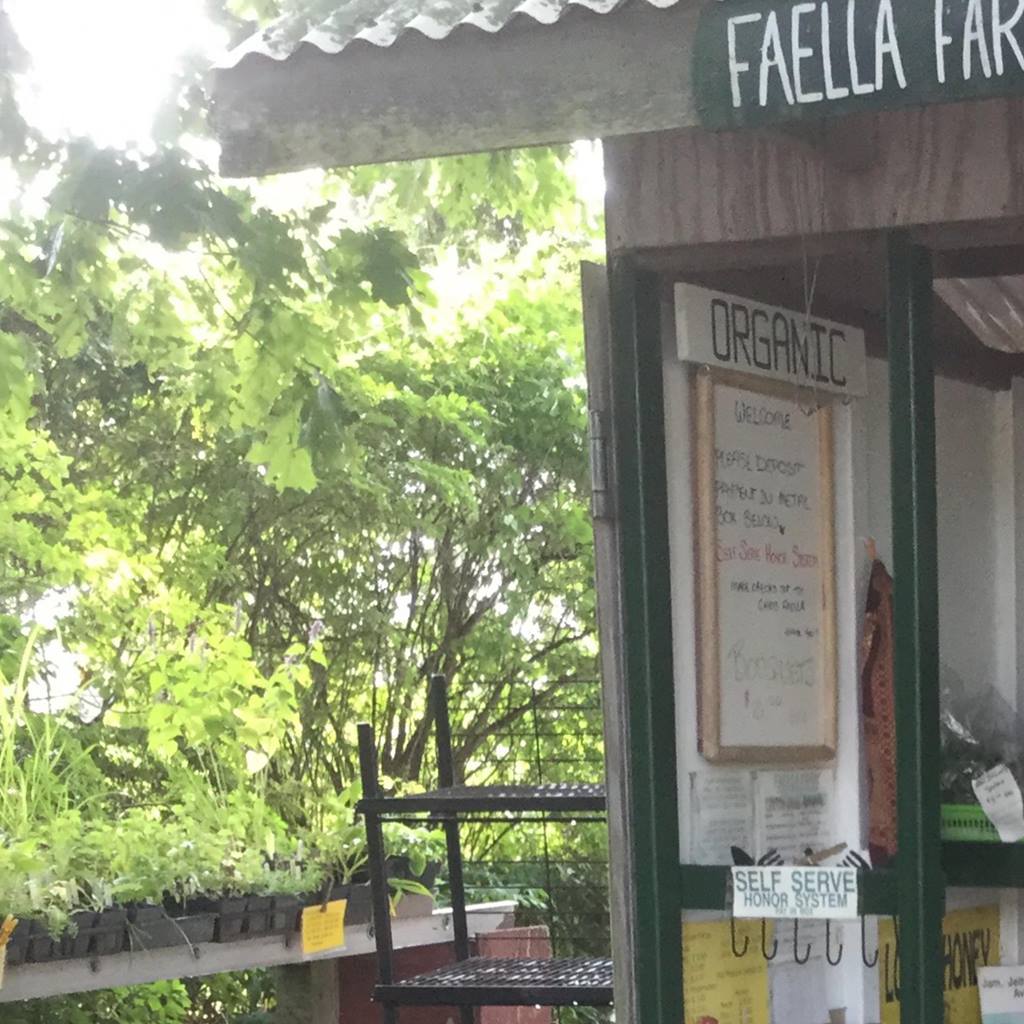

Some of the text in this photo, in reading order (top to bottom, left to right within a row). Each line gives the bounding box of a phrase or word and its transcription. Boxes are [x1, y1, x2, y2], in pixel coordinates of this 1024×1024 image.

[726, 0, 906, 107] FAELLA
[710, 298, 847, 387] ORGANIC
[734, 401, 792, 430] WELCOME
[735, 870, 856, 893] SELF SERVE
[744, 892, 848, 908] HONOR SYSTEM
